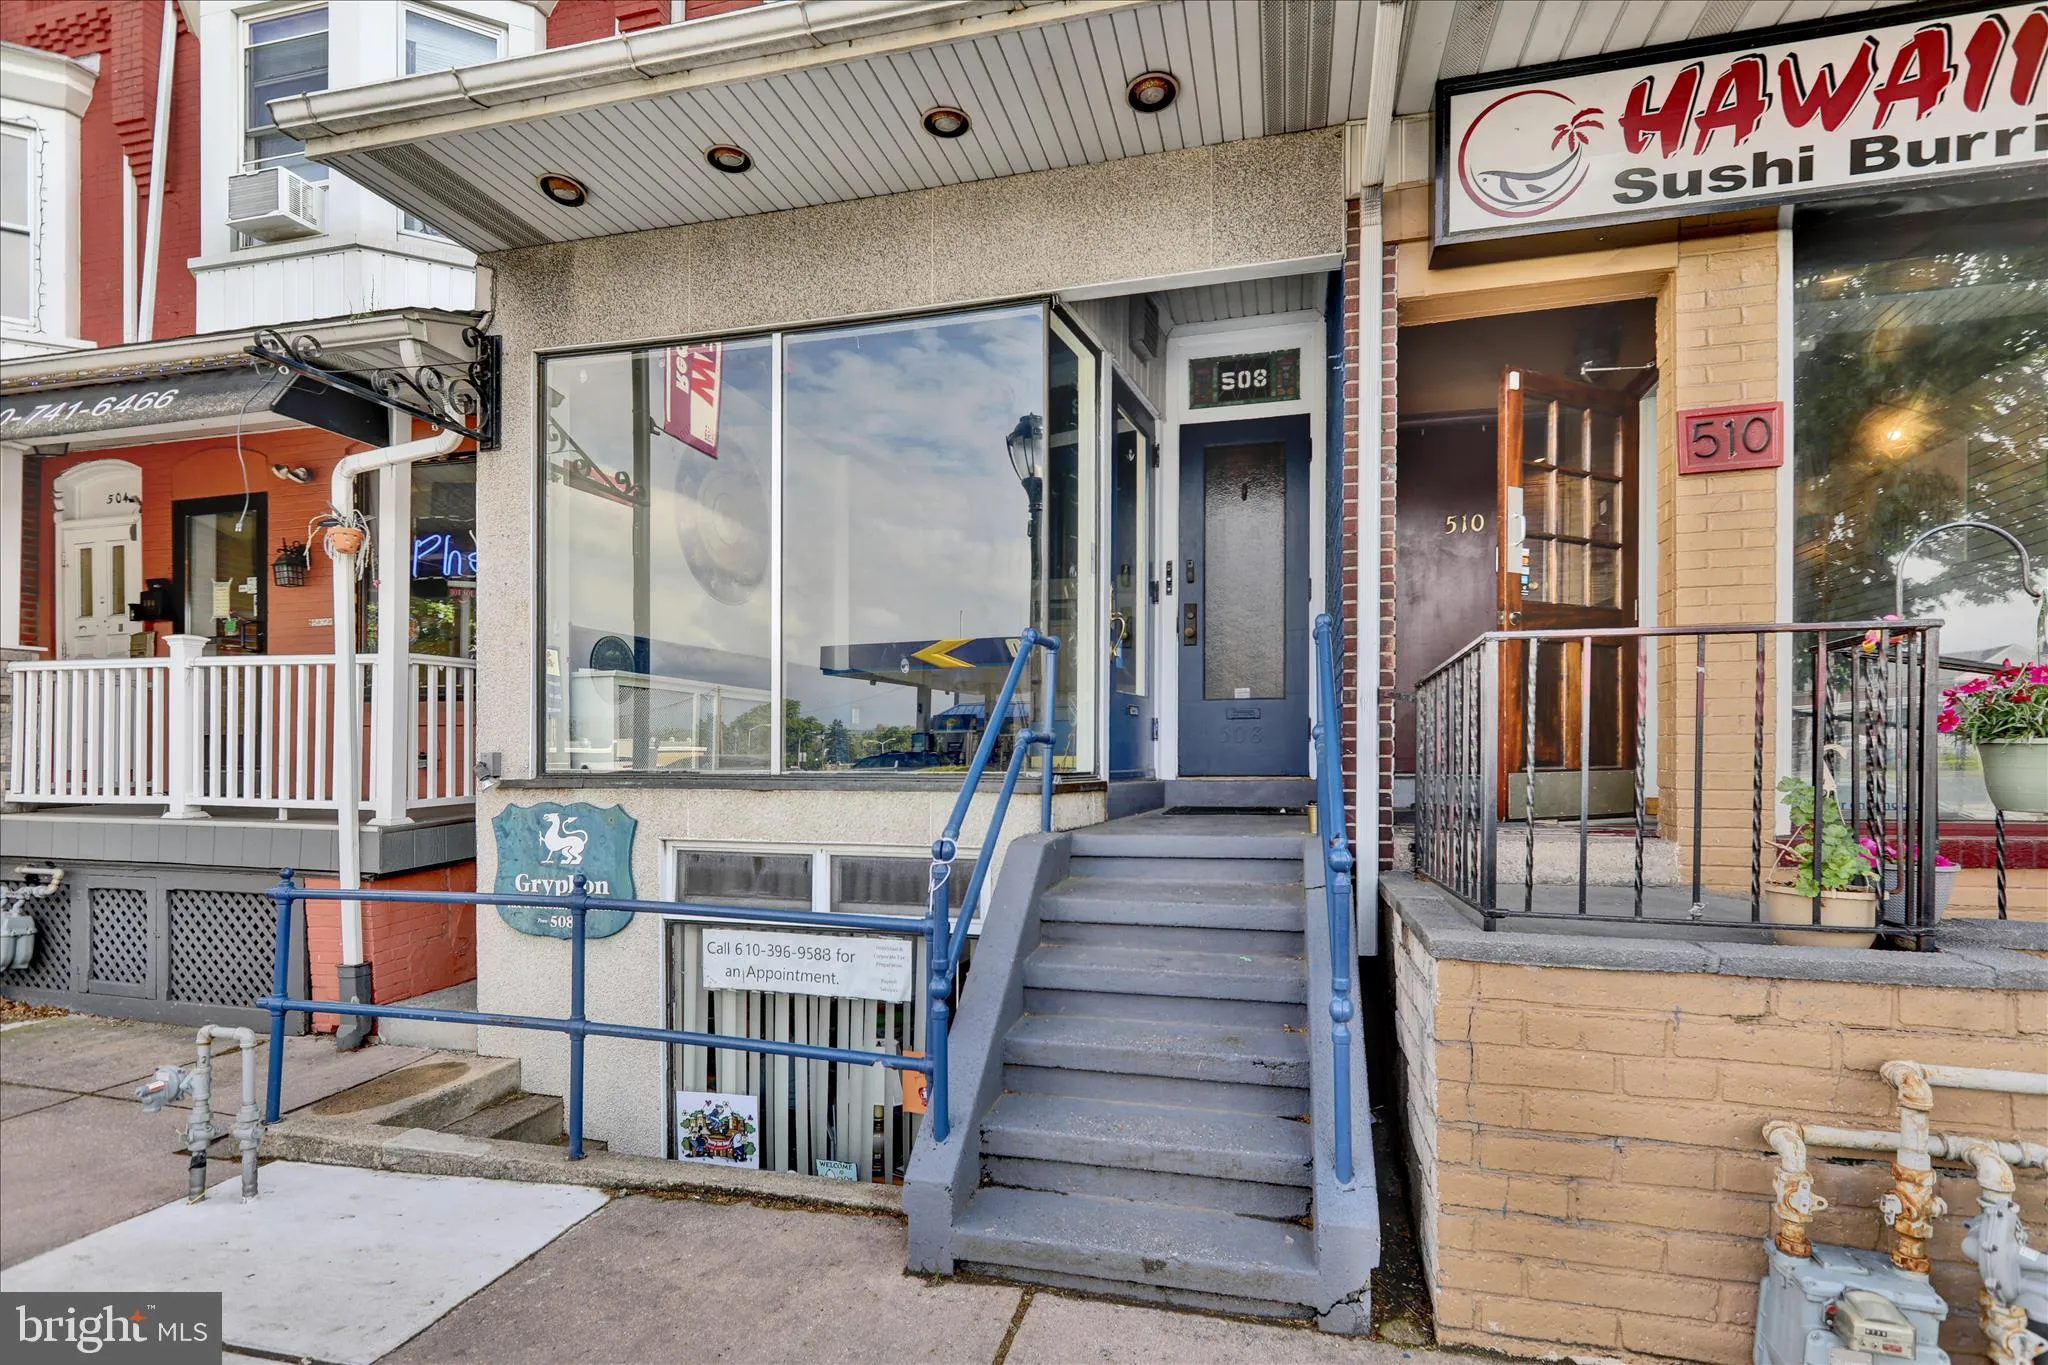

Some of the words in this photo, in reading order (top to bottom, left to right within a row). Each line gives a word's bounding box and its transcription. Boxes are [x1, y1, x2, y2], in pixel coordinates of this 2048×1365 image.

[1613, 144, 1815, 204] Sushi
[1221, 368, 1268, 391] 508
[0, 389, 179, 427] 0-741-6466
[1691, 415, 1772, 459] 510
[1445, 513, 1485, 535] 510
[1220, 726, 1264, 744] 508
[549, 915, 574, 929] 508
[706, 941, 730, 955] Call
[735, 942, 831, 962] 610-396-9588
[836, 949, 855, 963] for
[725, 967, 741, 978] an
[746, 965, 840, 985] Appointment.
[819, 1160, 853, 1171] WELCOME
